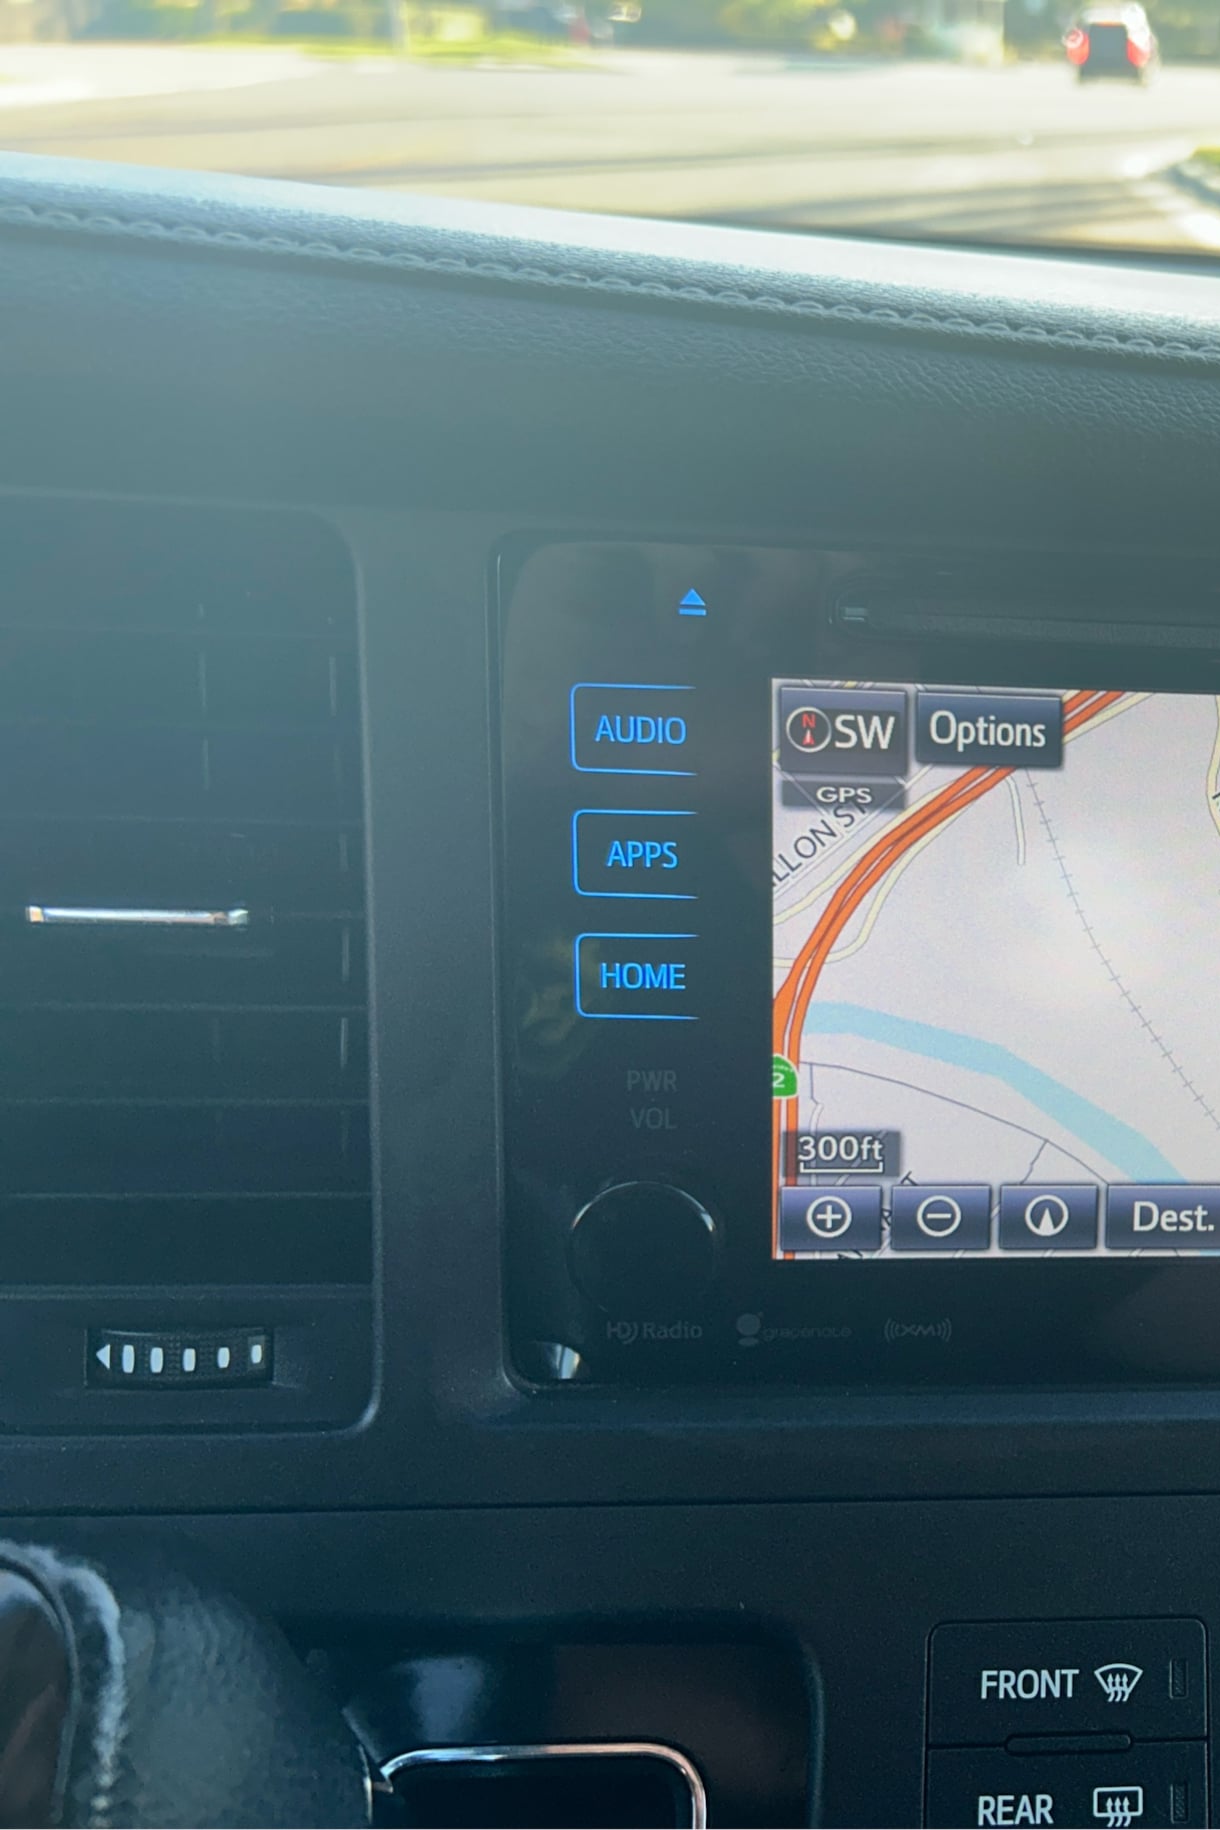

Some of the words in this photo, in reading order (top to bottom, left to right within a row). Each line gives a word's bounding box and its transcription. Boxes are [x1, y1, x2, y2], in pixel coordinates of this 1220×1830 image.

[595, 716, 687, 745] AUDIO
[834, 714, 896, 750] SW
[929, 710, 1047, 752] Options
[816, 786, 873, 804] GPS
[607, 841, 678, 869] APPS
[772, 819, 838, 886] LLON
[601, 962, 686, 990] HOME
[626, 1069, 678, 1092] PWR
[628, 1107, 677, 1130] VOL
[798, 1135, 883, 1163] 300ft
[1133, 1201, 1215, 1232] Dest.
[643, 1321, 704, 1340] Radio
[980, 1669, 1079, 1699] FRONT
[978, 1795, 1054, 1826] REAR
